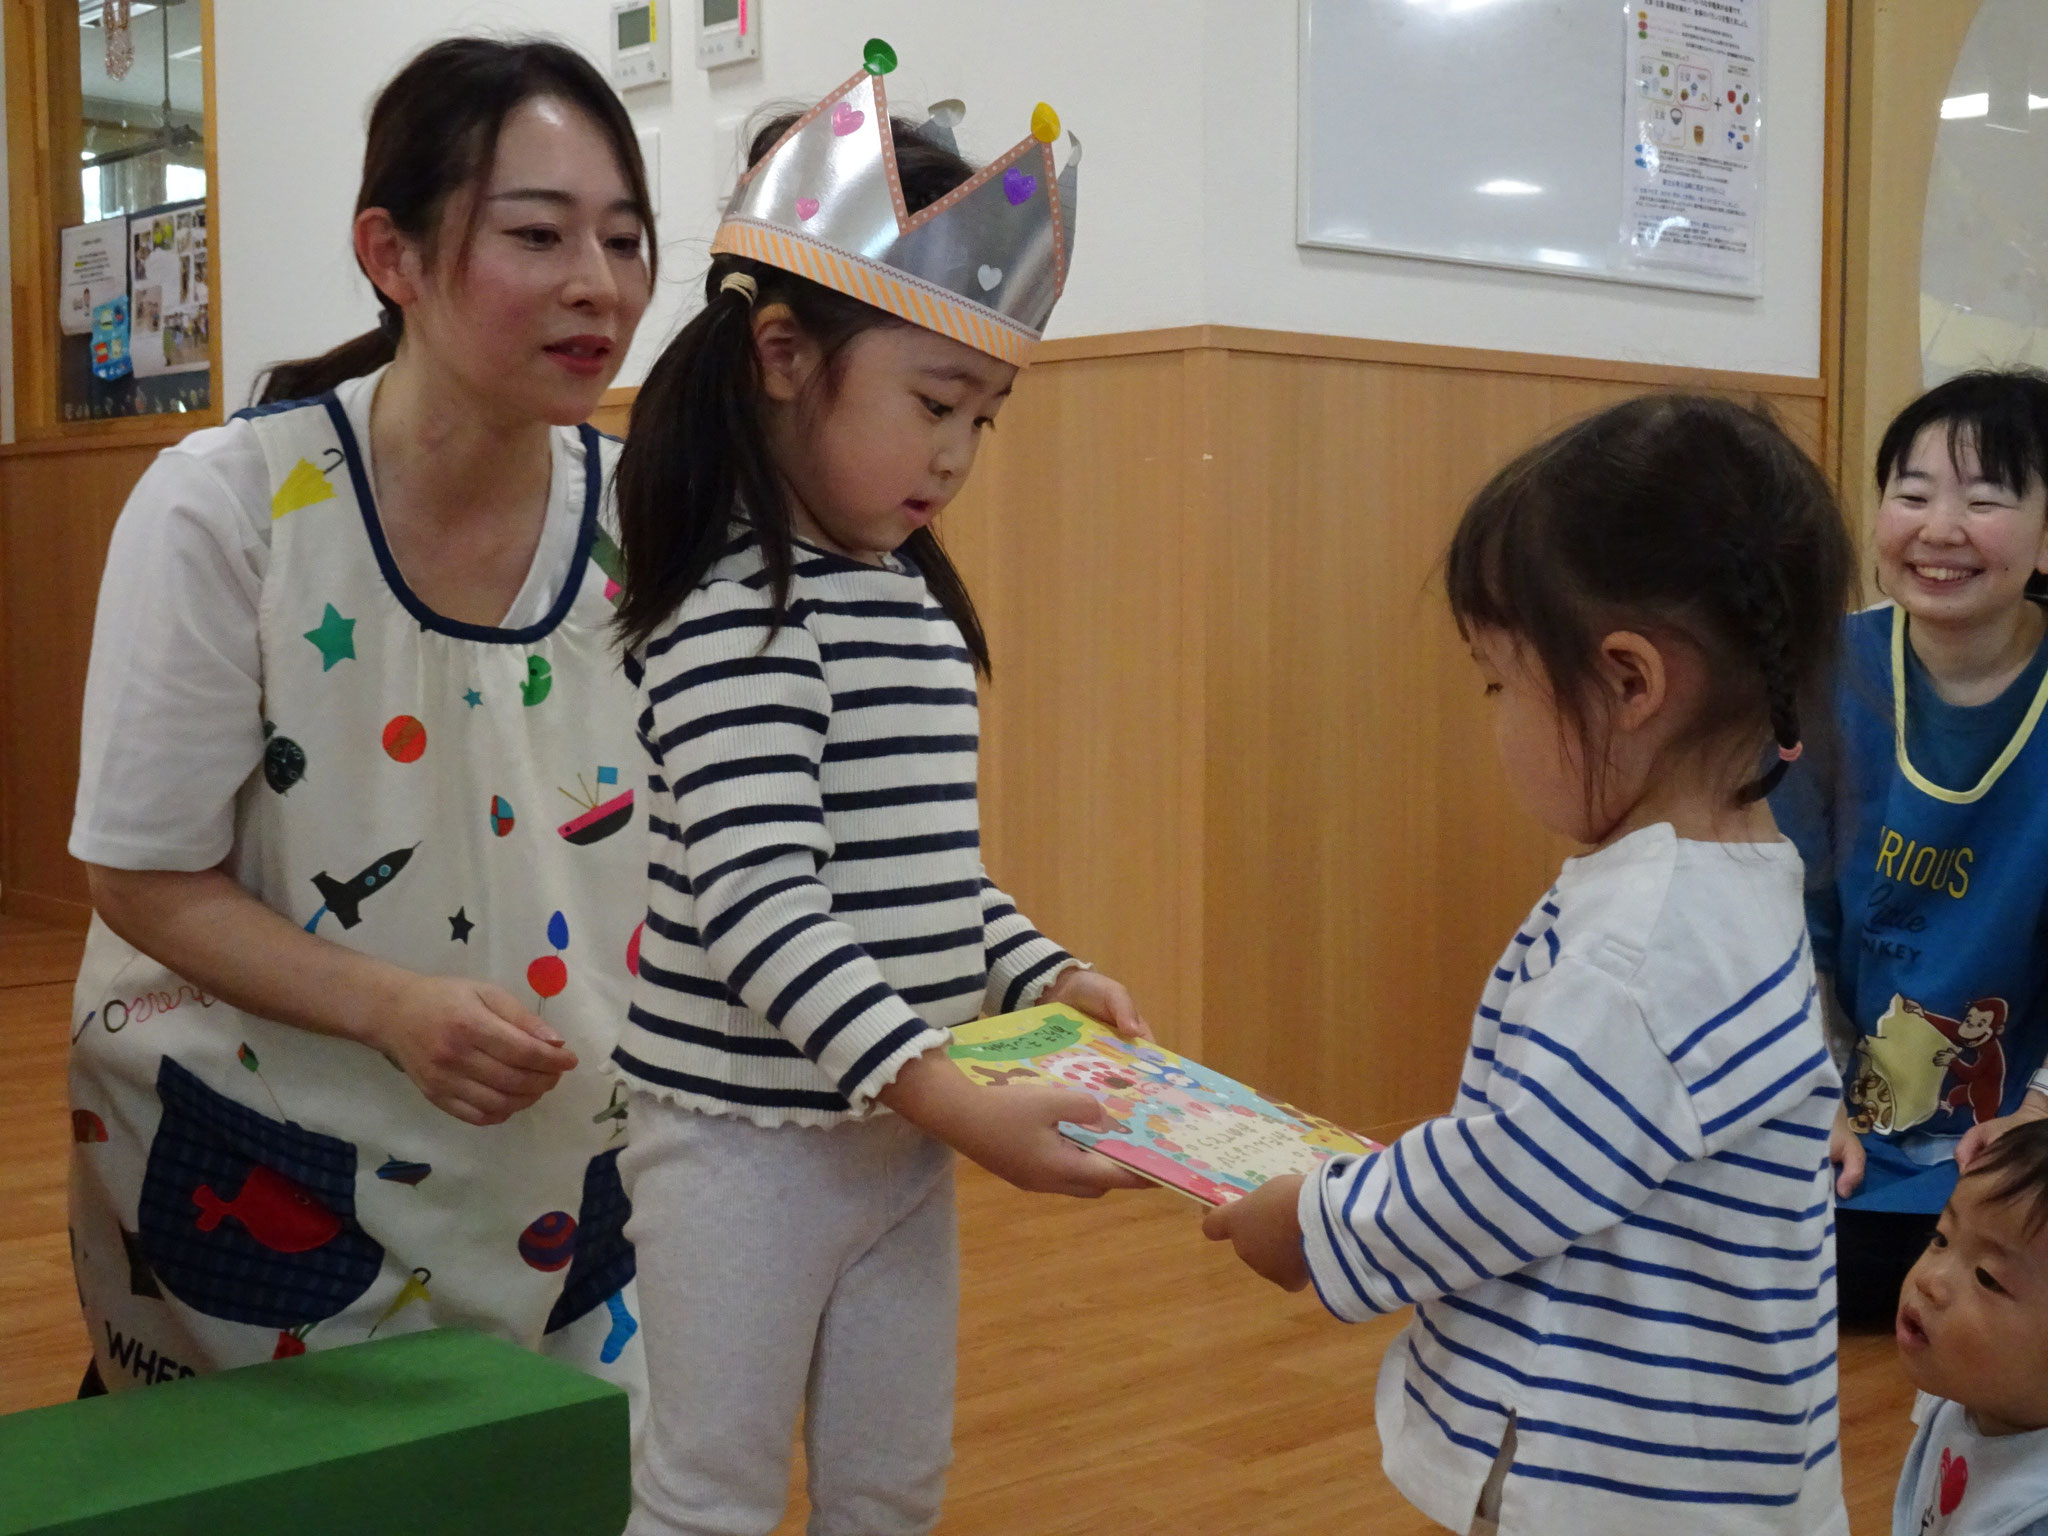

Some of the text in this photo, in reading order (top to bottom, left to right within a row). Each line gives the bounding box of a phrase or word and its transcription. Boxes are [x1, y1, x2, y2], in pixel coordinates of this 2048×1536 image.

[1875, 825, 1974, 899] RIOUS
[1197, 1121, 1258, 1148] おめでとう
